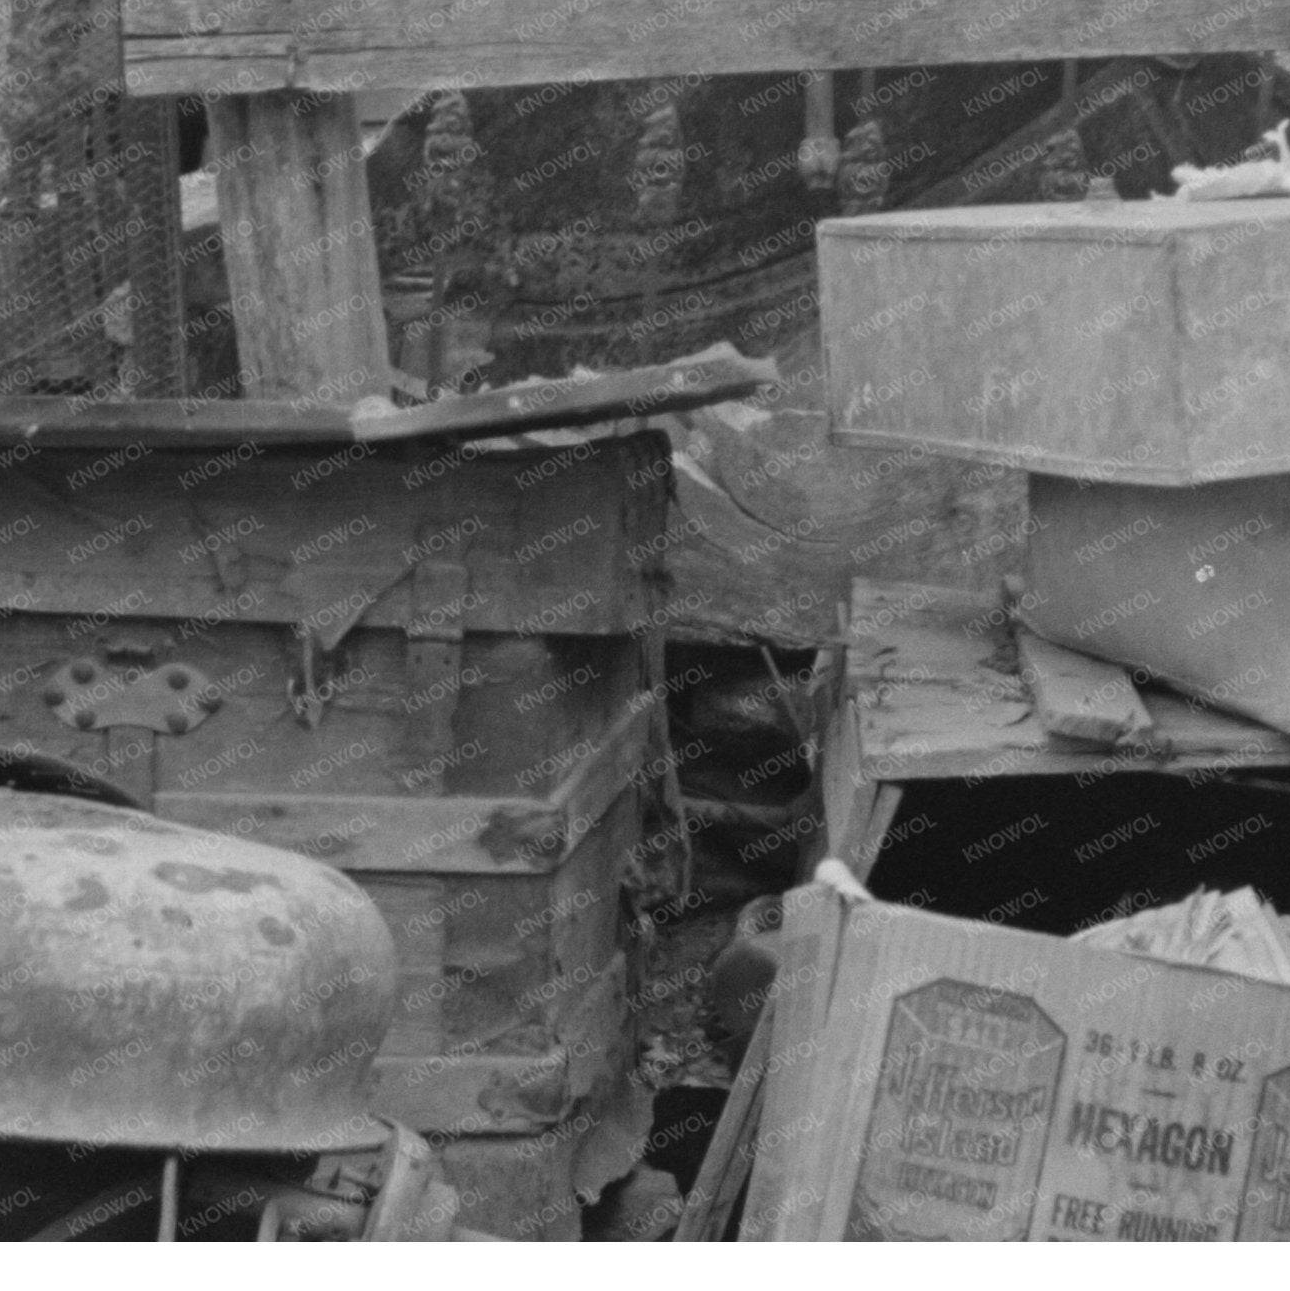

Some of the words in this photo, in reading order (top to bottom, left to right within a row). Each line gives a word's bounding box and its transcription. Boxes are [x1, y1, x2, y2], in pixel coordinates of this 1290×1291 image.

[887, 1045, 1049, 1123] Jefferson
[900, 1107, 1022, 1167] Island
[1066, 1101, 1235, 1176] HEXAGON
[1050, 1192, 1110, 1235] FREE
